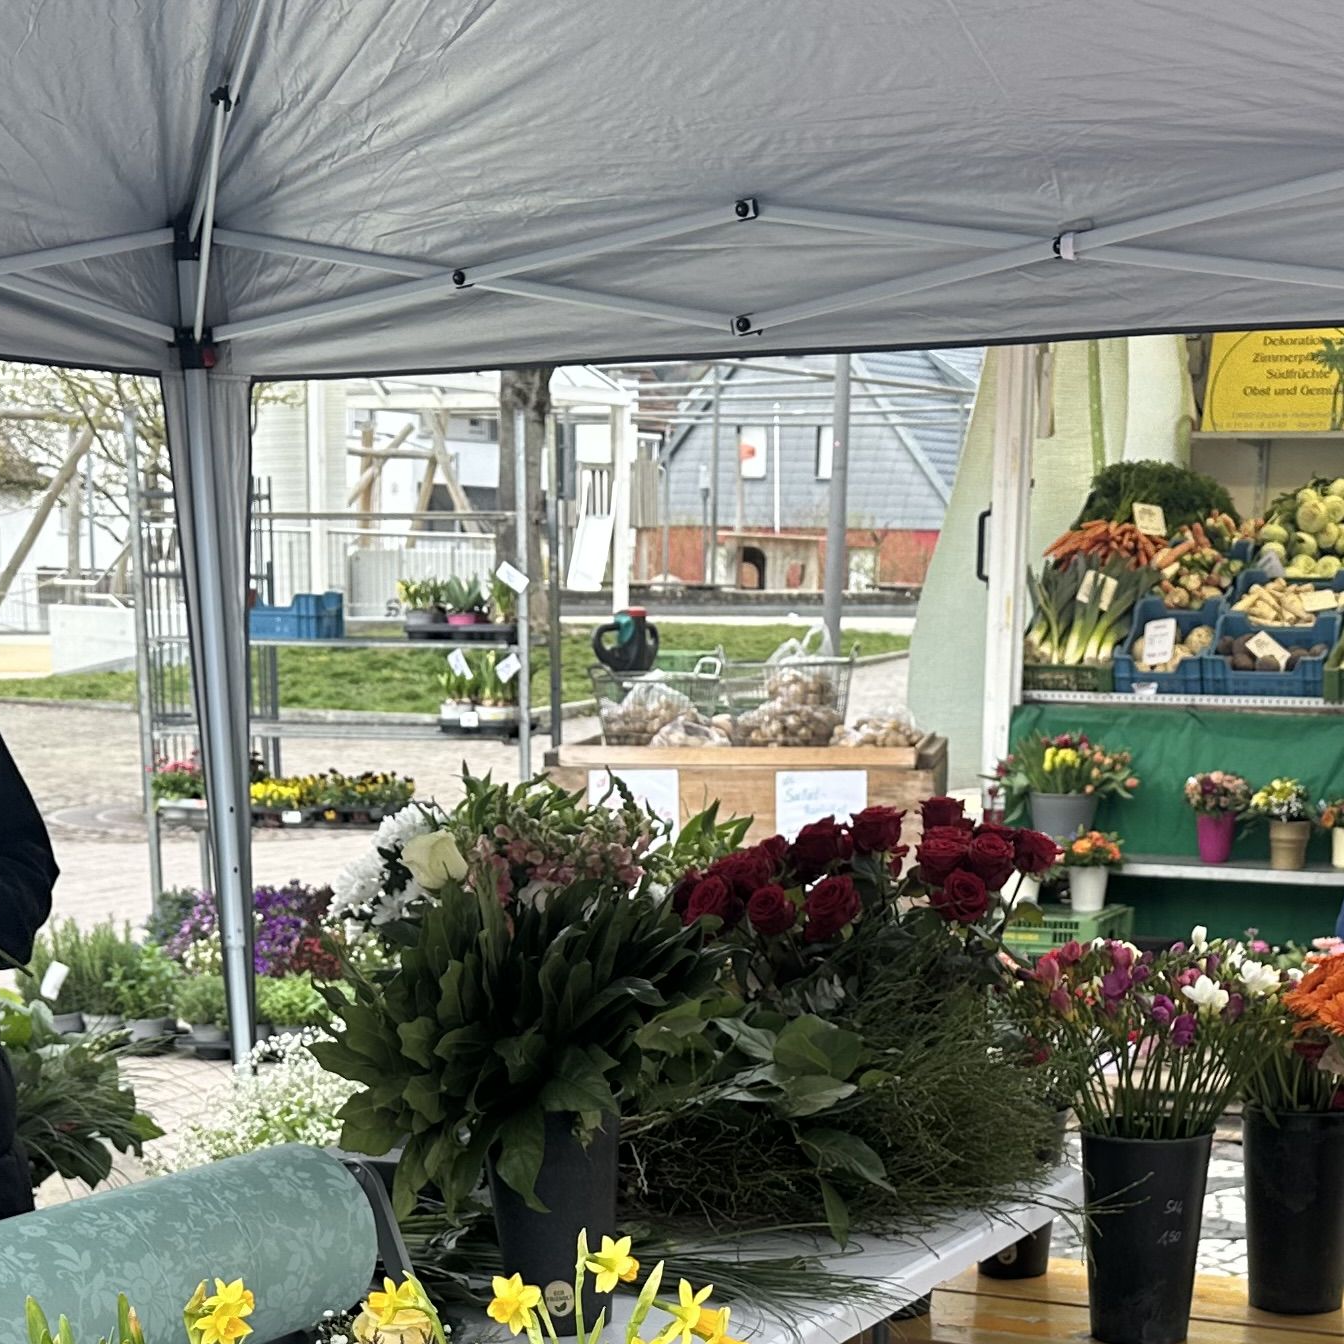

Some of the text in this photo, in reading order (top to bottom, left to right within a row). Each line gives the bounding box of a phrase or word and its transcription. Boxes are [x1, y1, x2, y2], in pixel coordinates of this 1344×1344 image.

[1266, 368, 1331, 379] Südfrüchte
[1243, 386, 1271, 397] Obst
[1274, 385, 1298, 396] und
